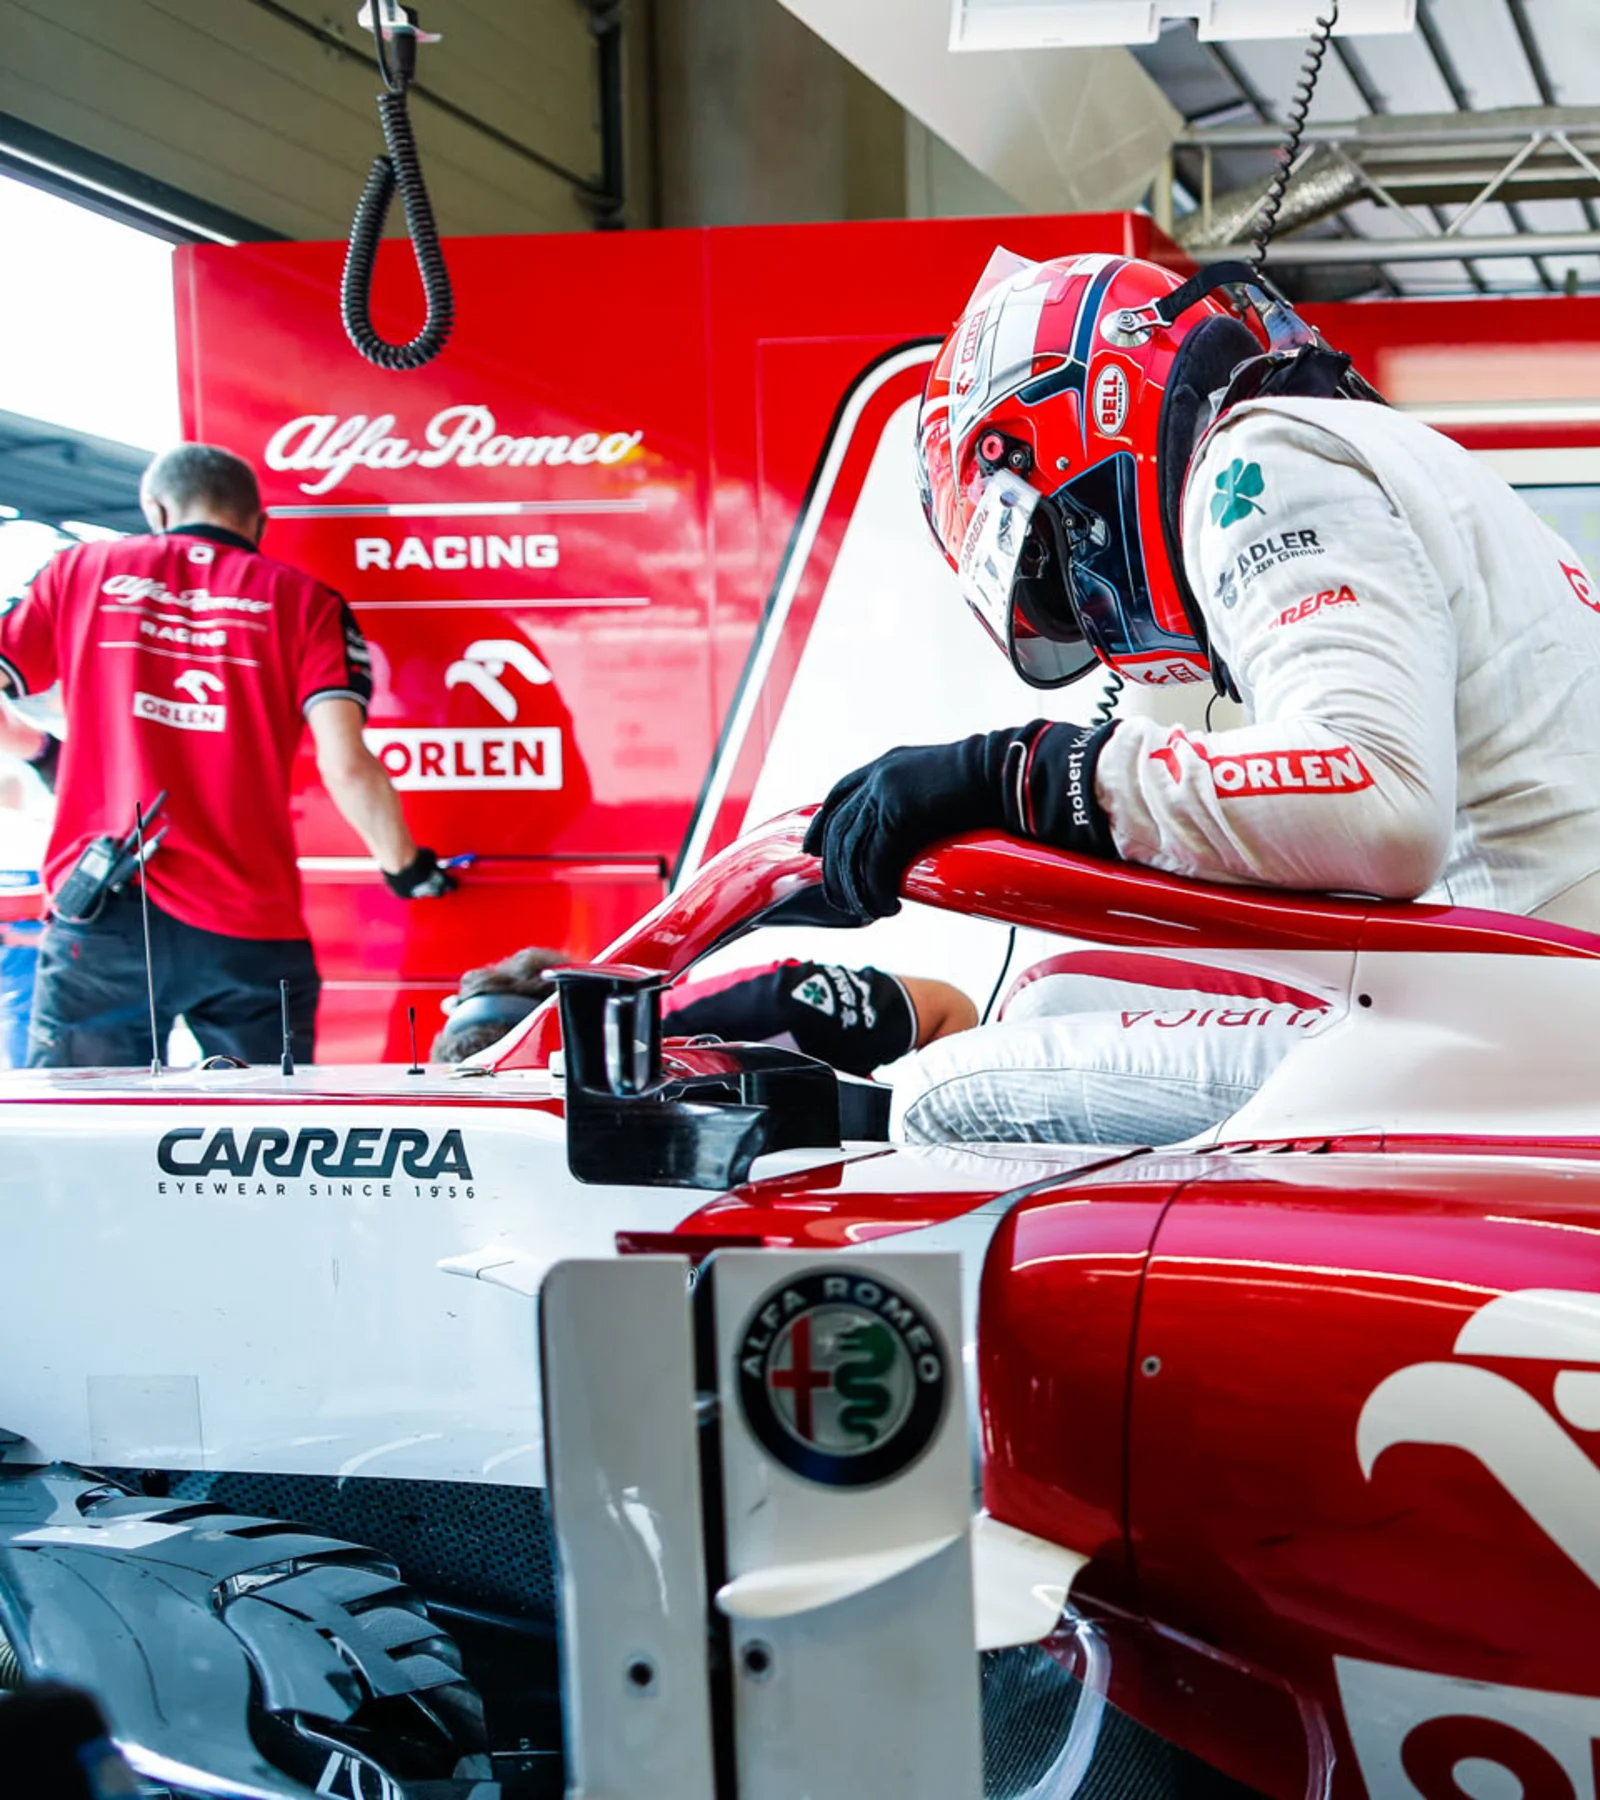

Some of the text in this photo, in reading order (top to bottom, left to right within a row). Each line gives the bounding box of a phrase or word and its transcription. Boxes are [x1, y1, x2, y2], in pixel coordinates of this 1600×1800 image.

[1102, 375, 1118, 425] BELL
[264, 404, 644, 496] Alfa Romeo
[354, 534, 560, 571] RACING
[1237, 529, 1321, 578] ADLER
[140, 620, 228, 647] RACING
[142, 700, 217, 725] ORLEN
[379, 740, 544, 778] ORLEN
[1213, 750, 1365, 791] ORLEN
[1066, 752, 1090, 826] Robert
[157, 1127, 474, 1181] CARRERA
[158, 1182, 475, 1200] EYEWEAR SINCE 1956
[742, 1276, 941, 1384] ALFA ROMEO
